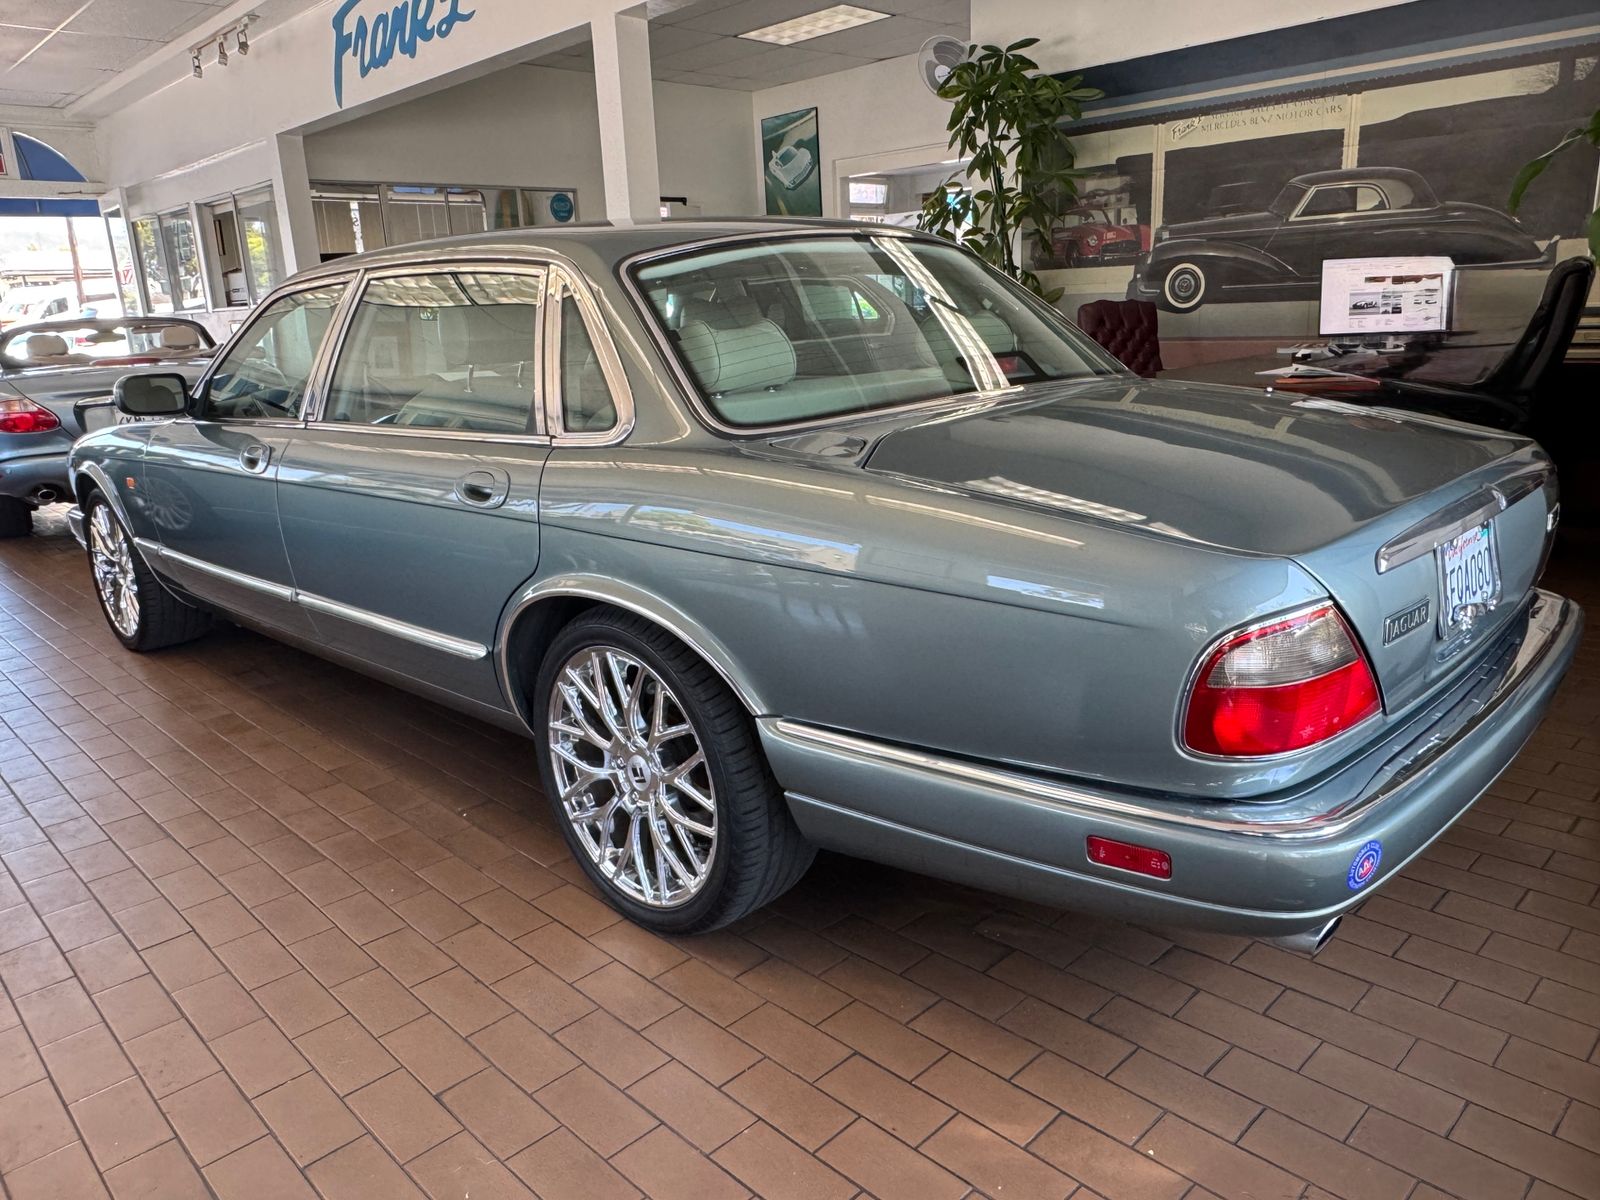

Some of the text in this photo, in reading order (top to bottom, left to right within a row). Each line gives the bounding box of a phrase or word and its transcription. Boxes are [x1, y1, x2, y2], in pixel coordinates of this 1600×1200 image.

[1201, 119, 1247, 132] MERCEDES
[1276, 108, 1314, 121] MOTOR
[1316, 104, 1343, 116] CARS
[1445, 546, 1491, 618] FQA080
[1385, 606, 1427, 643] JAGUAR
